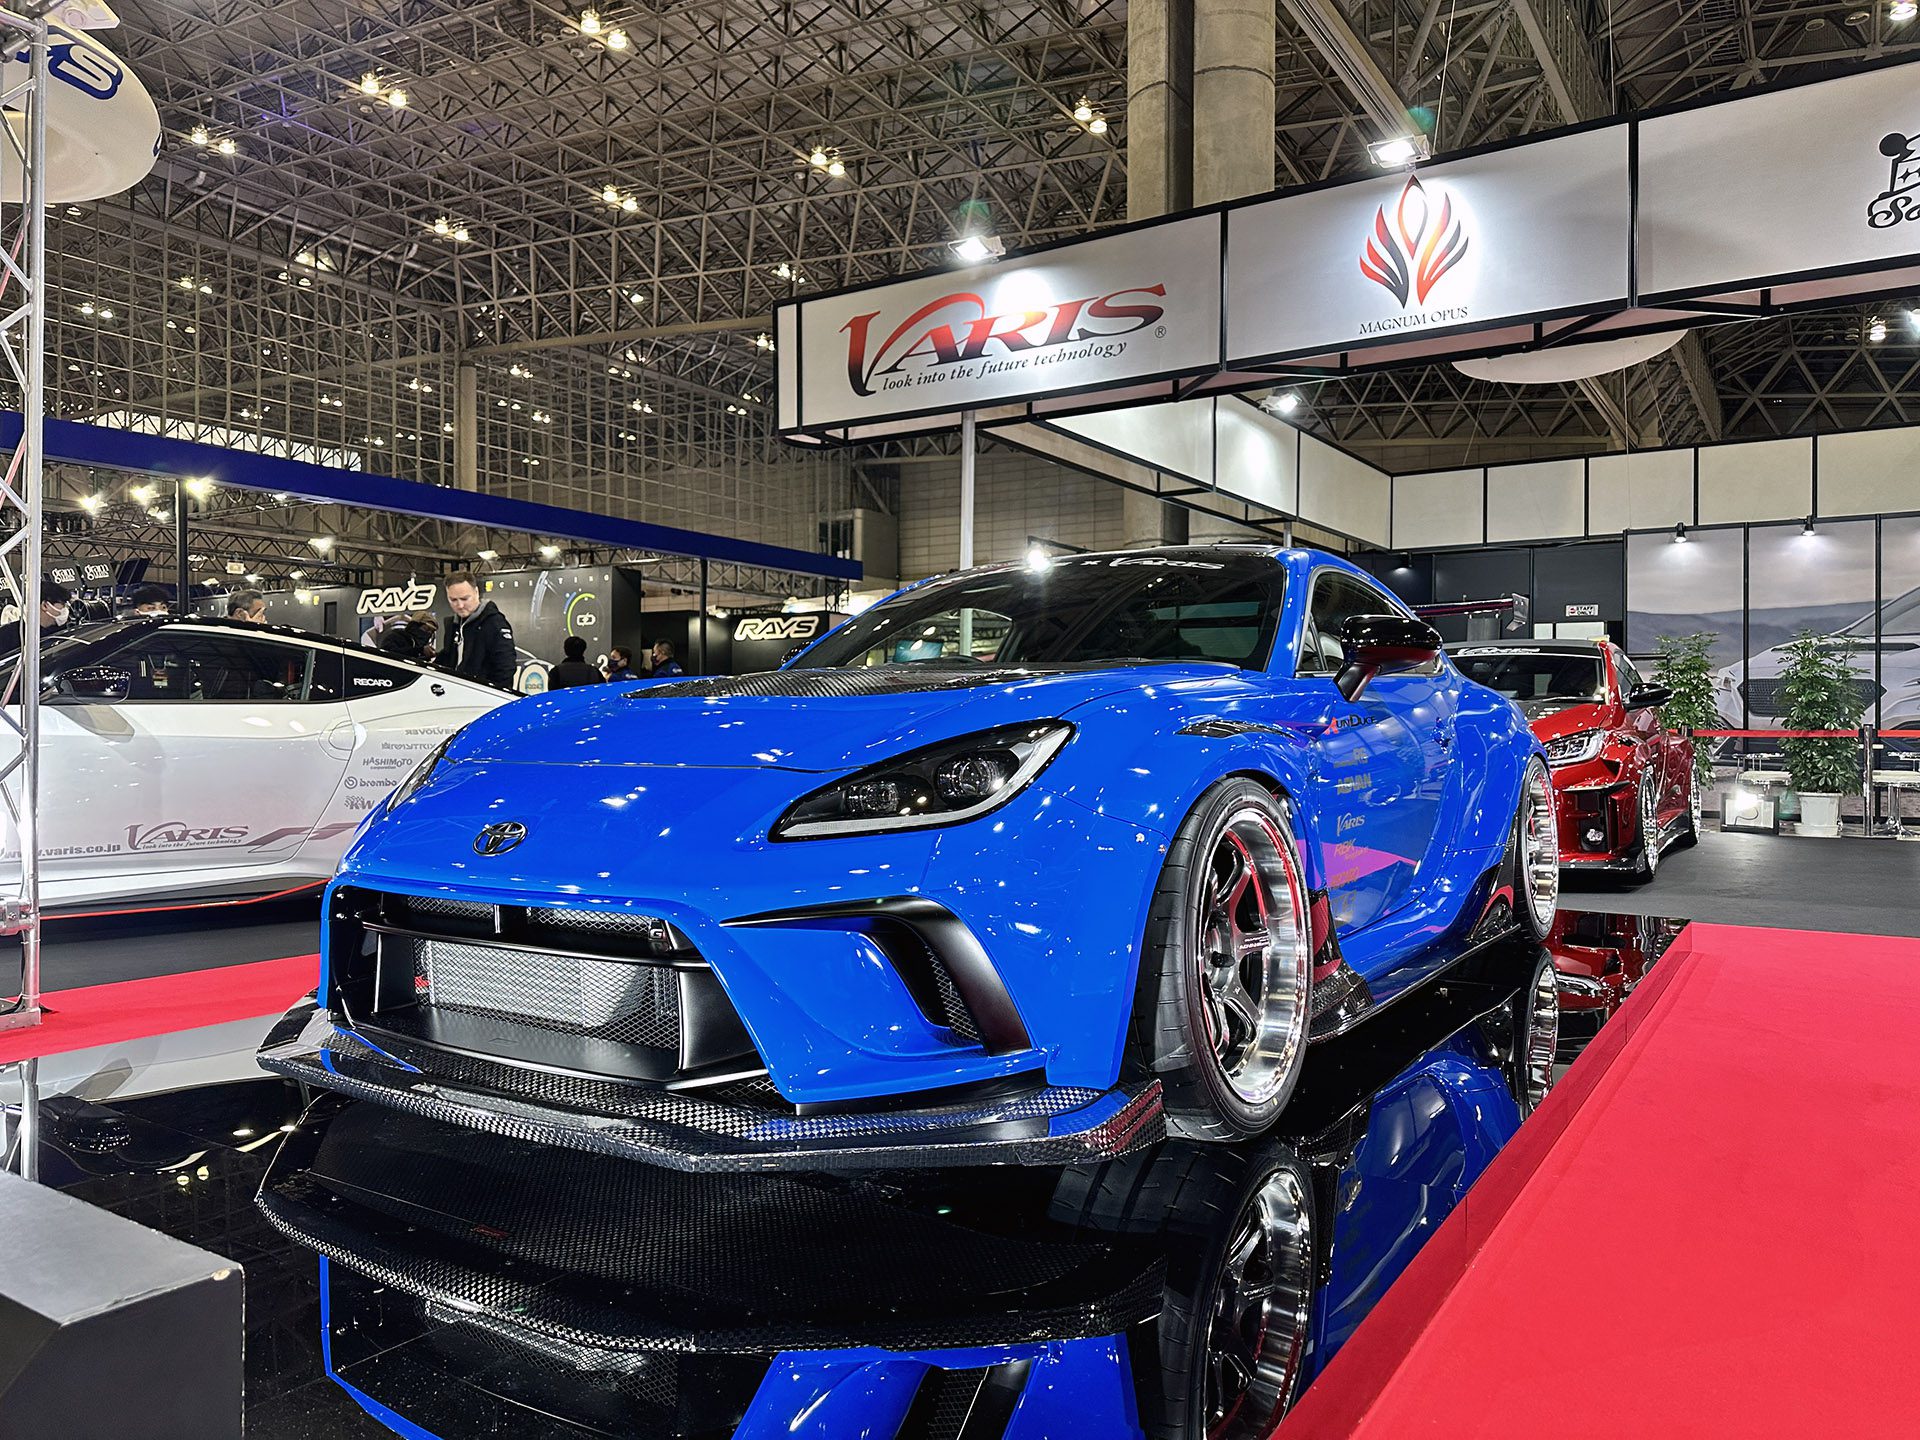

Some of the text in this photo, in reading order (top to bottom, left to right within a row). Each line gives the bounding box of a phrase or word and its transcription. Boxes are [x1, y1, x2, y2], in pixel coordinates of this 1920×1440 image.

[1359, 306, 1469, 335] MAGNUM OPUS
[839, 283, 1167, 397] VARIS
[882, 340, 1128, 391] look into the future technology
[356, 584, 437, 614] RAYS
[734, 616, 819, 641] RAYS
[353, 677, 393, 688] RECARO
[362, 756, 413, 768] HASHIMOTO
[359, 778, 398, 787] brembo
[349, 800, 375, 810] KW
[124, 821, 249, 850] VARIS
[1336, 812, 1366, 837] VARIS
[206, 838, 242, 846] technology
